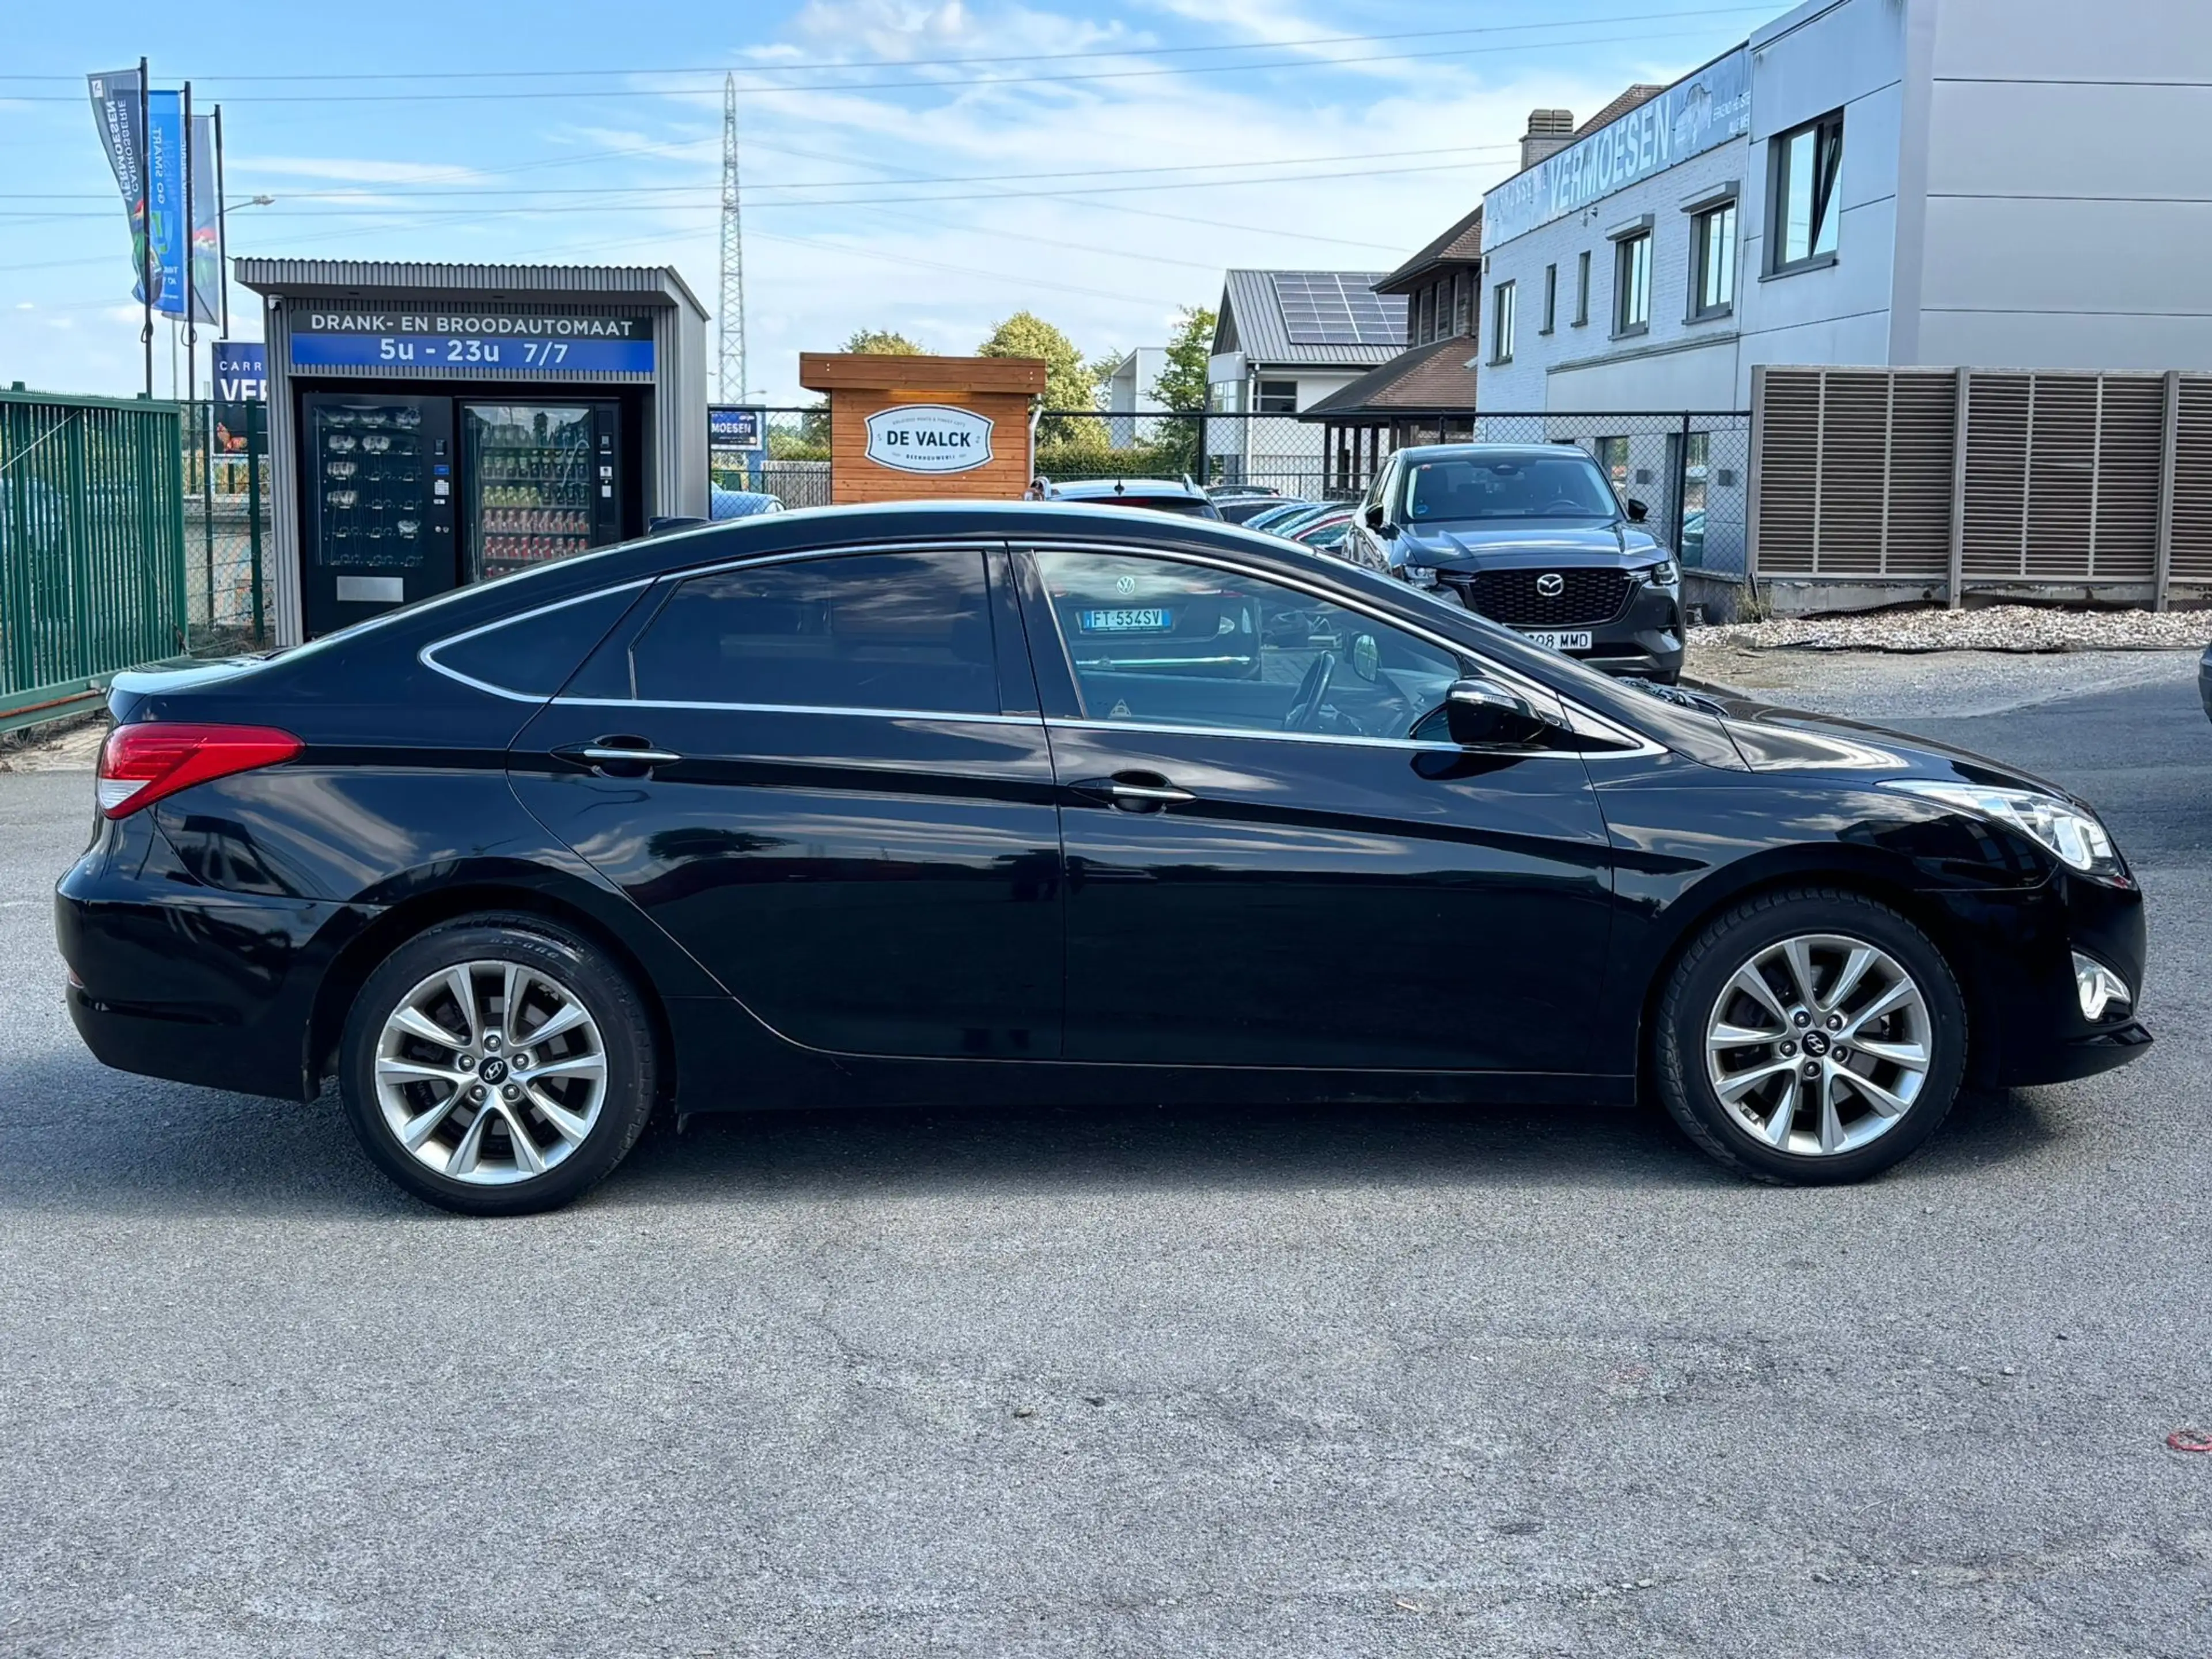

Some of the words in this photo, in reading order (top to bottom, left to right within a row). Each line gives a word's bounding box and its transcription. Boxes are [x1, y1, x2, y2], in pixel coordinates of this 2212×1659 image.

[1551, 94, 1670, 213] VERMOESEN
[311, 315, 394, 332] DRANK-
[402, 316, 429, 332] EN
[436, 316, 633, 336] BROODAUTOMAAT
[380, 339, 414, 361] 5u
[446, 340, 499, 363] 23u
[524, 343, 568, 366] 7/7
[887, 431, 909, 446] DE
[915, 431, 971, 448] VALCK
[1094, 611, 1111, 626] FT
[1116, 611, 1160, 626] 534SV
[1560, 634, 1588, 647] MMD
